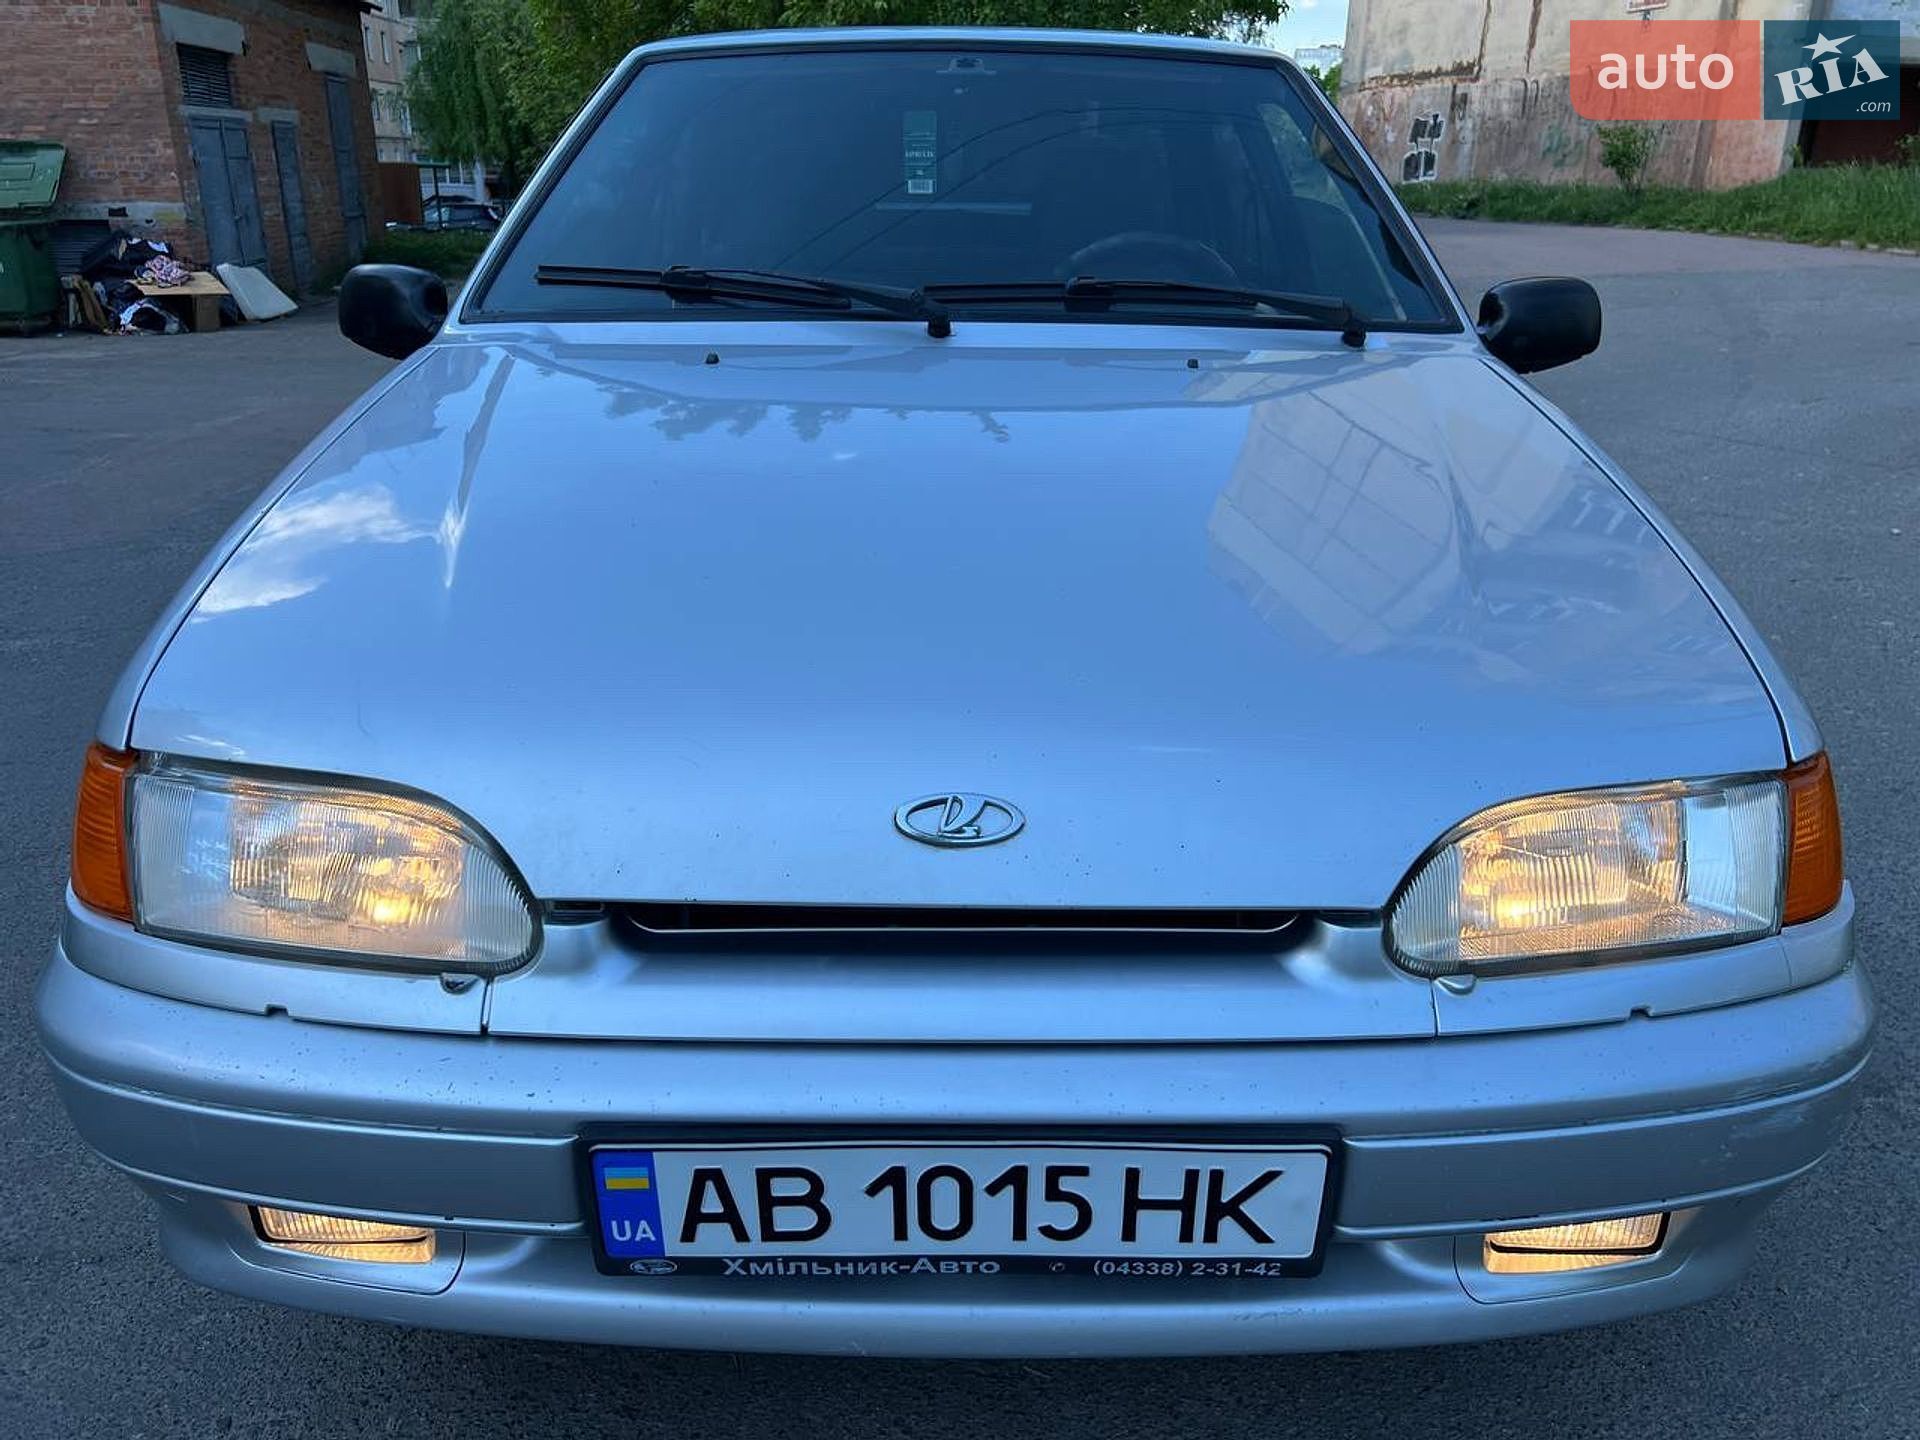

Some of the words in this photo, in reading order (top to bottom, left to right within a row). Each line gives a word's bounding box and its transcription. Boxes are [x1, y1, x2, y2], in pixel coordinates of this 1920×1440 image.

[680, 1167, 832, 1243] AB
[864, 1165, 1093, 1241] 1015
[1121, 1166, 1285, 1244] HK
[611, 1220, 656, 1242] UA
[1093, 1260, 1182, 1276] (04338)
[1191, 1262, 1282, 1276] 2-31-42
